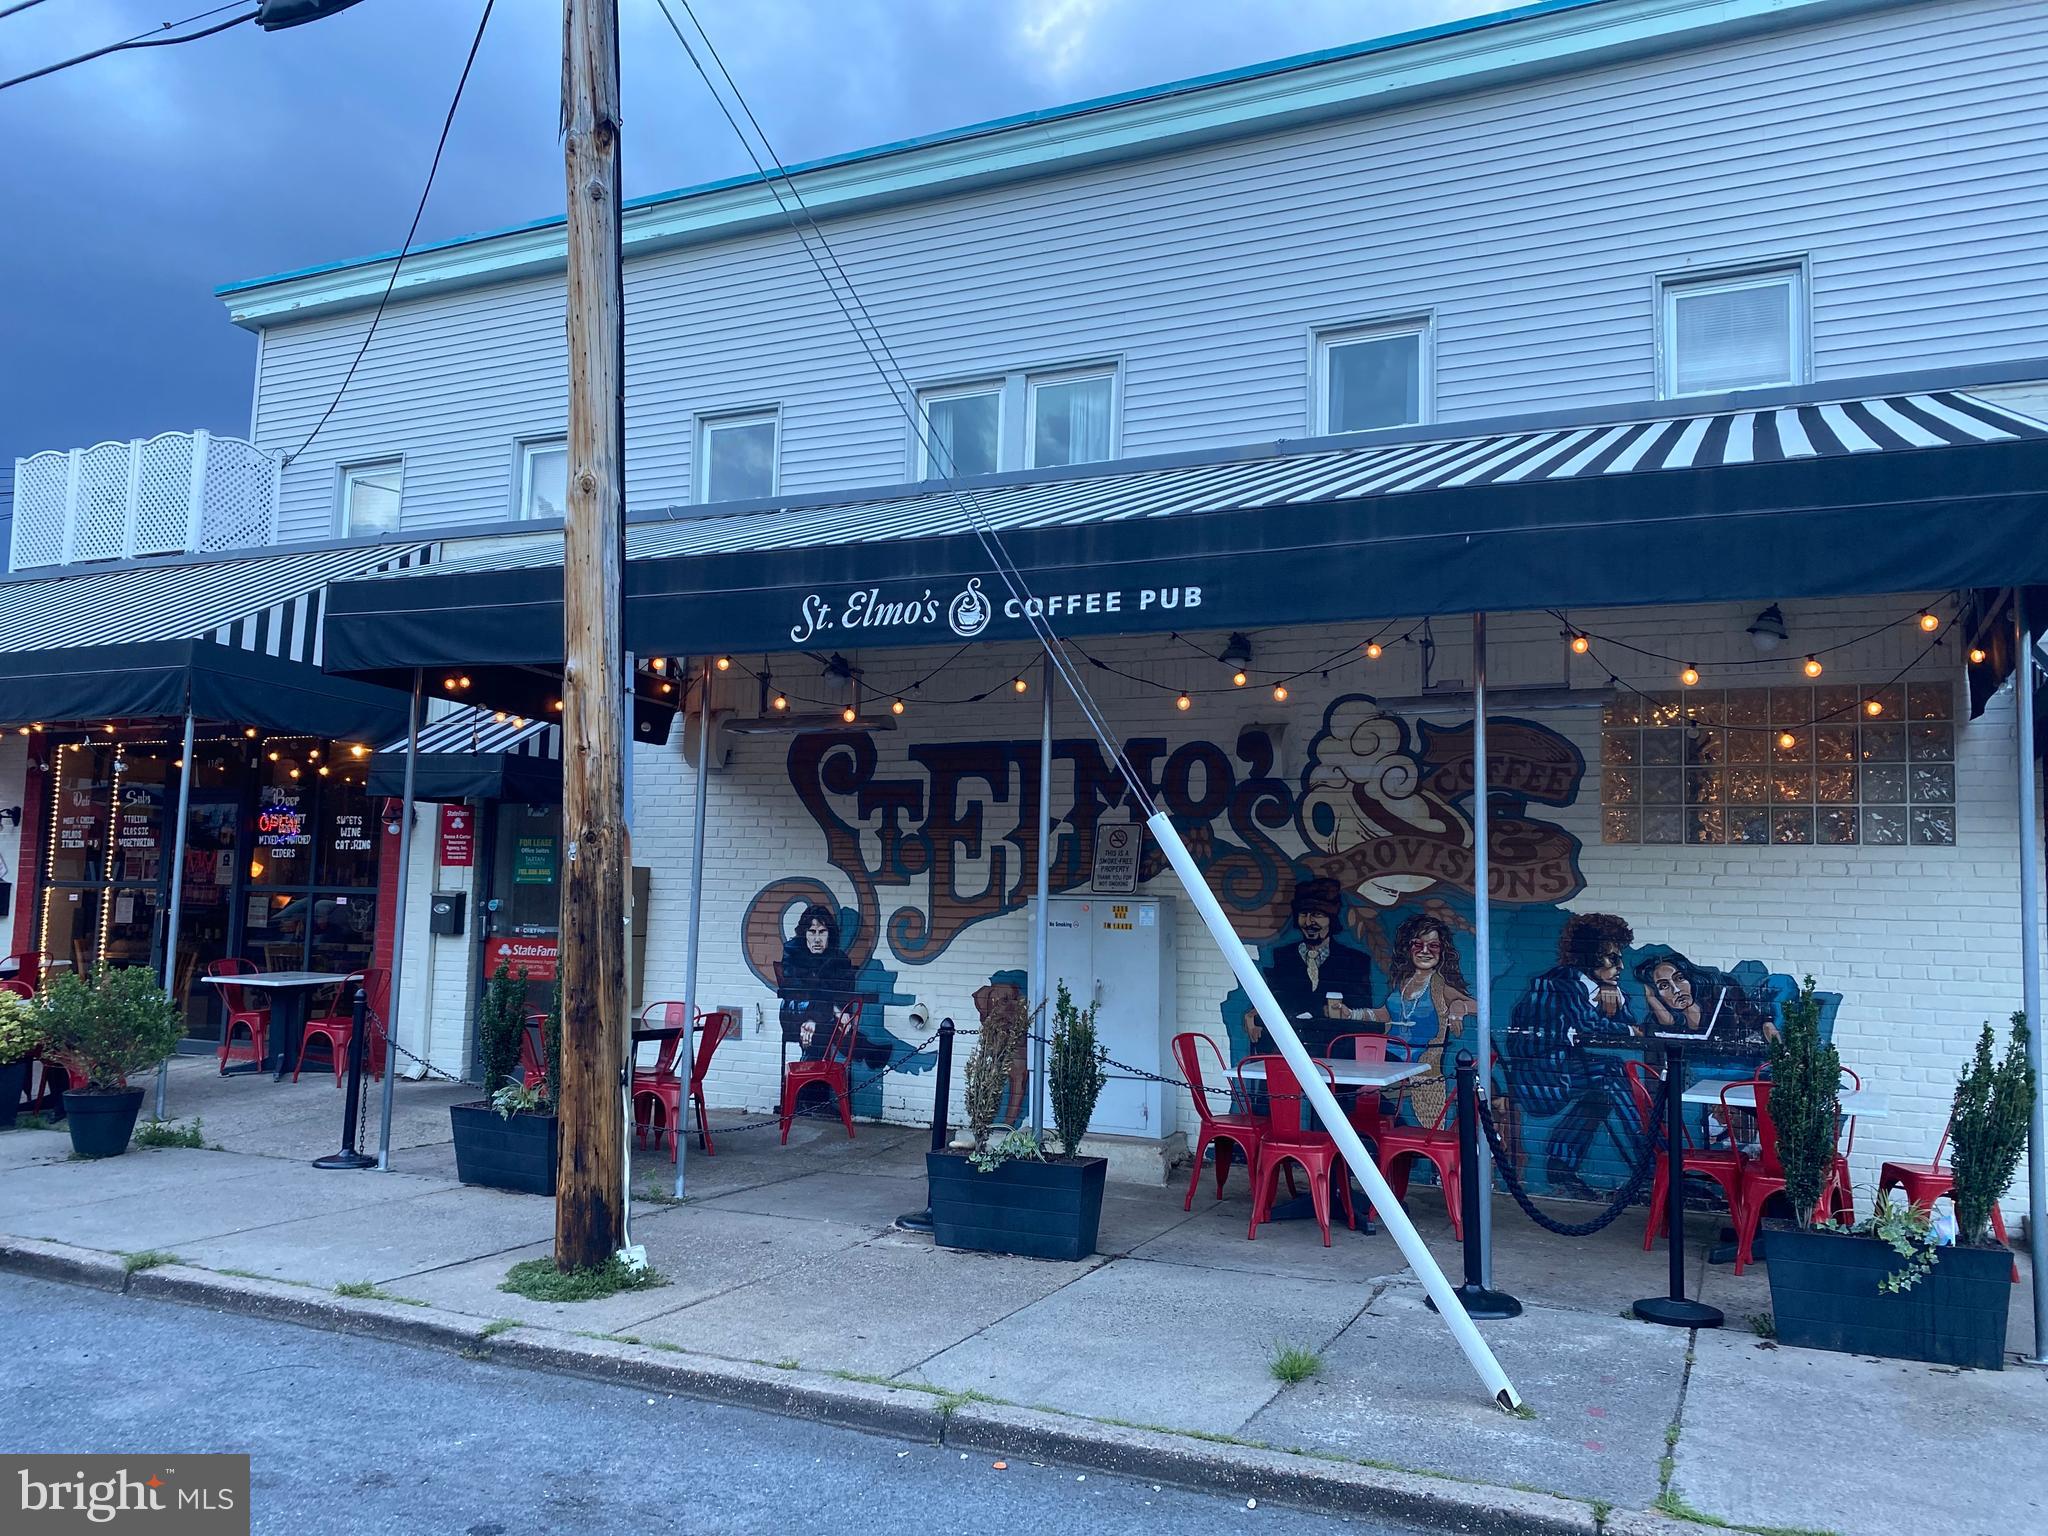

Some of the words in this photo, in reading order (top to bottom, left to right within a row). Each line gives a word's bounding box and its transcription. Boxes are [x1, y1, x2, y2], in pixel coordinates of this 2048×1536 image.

[790, 594, 834, 643] St.
[841, 588, 940, 628] Elmo's
[1004, 591, 1121, 618] COFFEE
[1140, 586, 1202, 612] PUB
[123, 827, 149, 836] CLASSIC
[341, 827, 361, 837] WINE
[272, 848, 295, 858] CIDERS
